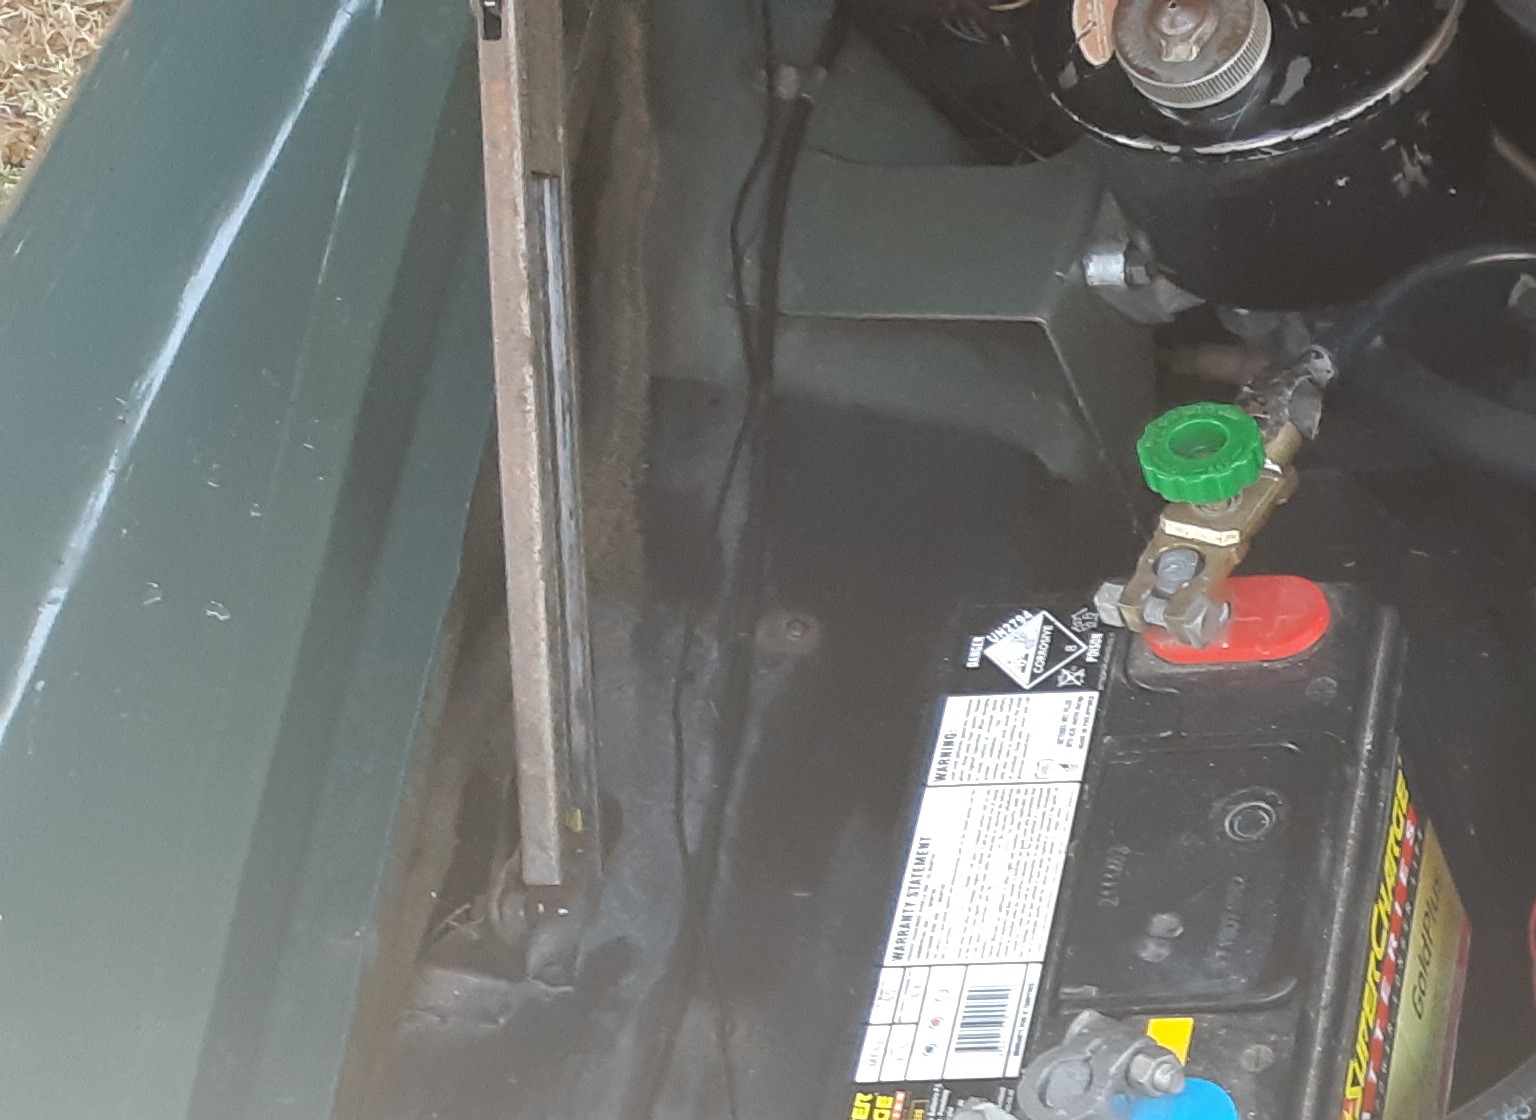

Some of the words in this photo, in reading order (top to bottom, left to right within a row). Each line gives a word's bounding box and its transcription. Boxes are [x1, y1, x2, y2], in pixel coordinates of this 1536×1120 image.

[986, 610, 1033, 643] UN2794
[966, 637, 985, 668] DANGER
[1033, 625, 1054, 674] CORROSIVE
[1086, 633, 1104, 663] POISON
[892, 902, 915, 961] WARRANTY
[907, 837, 932, 898] STATEMENT
